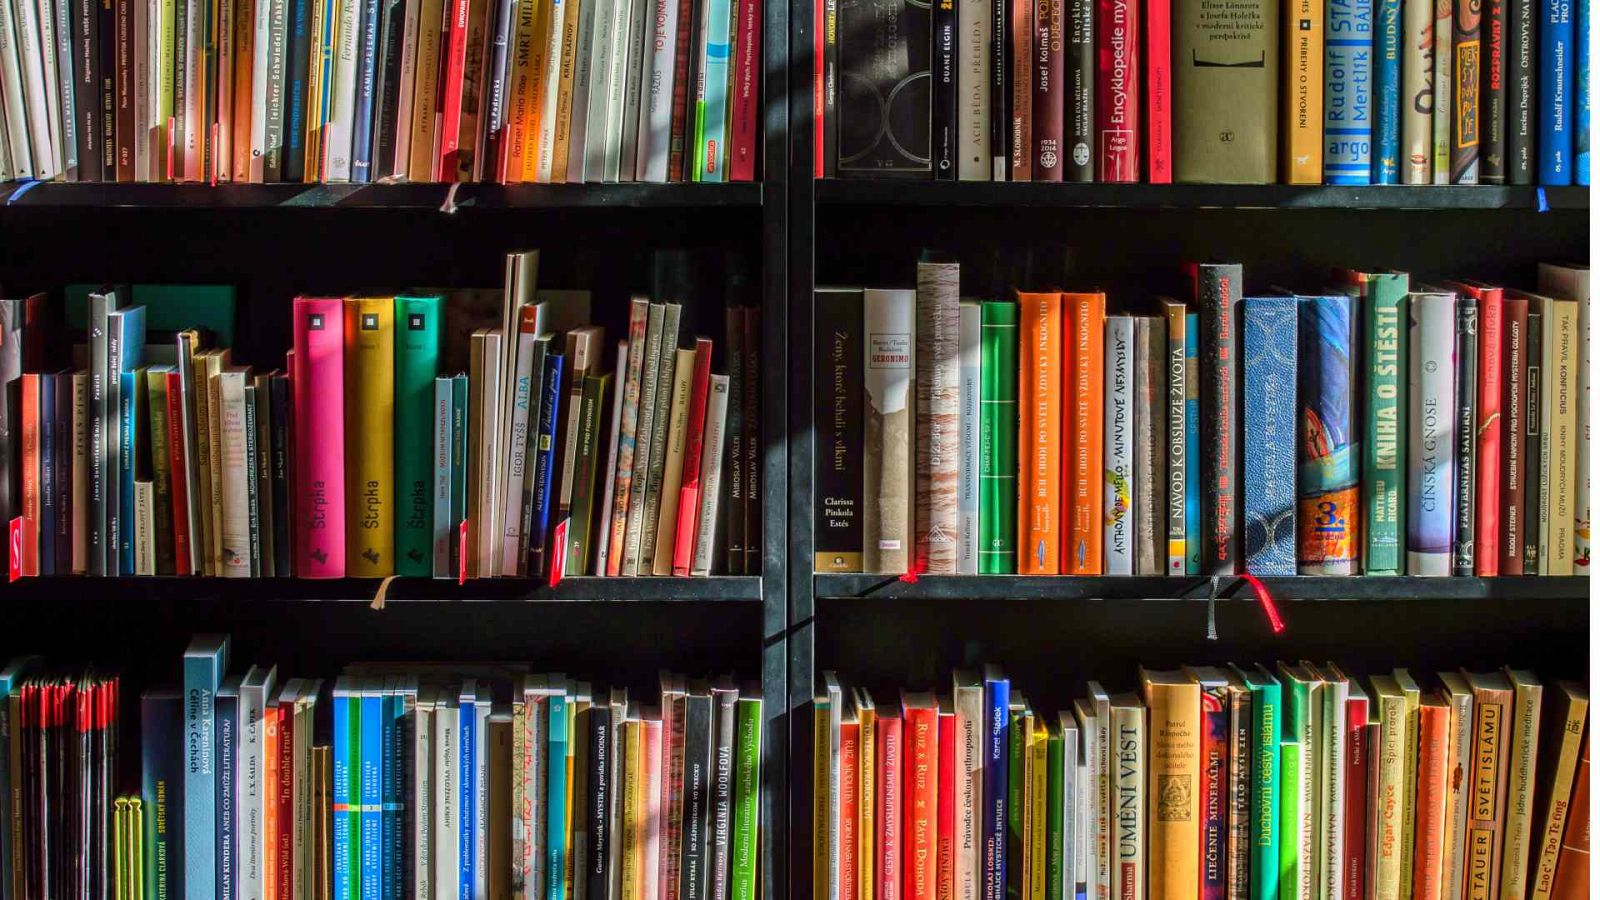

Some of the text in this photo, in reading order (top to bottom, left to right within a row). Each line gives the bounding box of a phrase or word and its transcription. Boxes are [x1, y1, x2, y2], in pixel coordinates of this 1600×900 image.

[943, 53, 951, 84] DUANE
[1039, 27, 1049, 92] Josef Kolmaš
[1110, 26, 1127, 124] Encyklopedie
[1489, 20, 1501, 90] ROZPRÁVKY
[1328, 50, 1346, 121] Rudolf
[1519, 110, 1529, 136] Lucien
[1554, 105, 1564, 132] Rudolf
[1329, 142, 1369, 162] argo
[516, 376, 529, 411] ALBA
[1038, 301, 1048, 443] PO INKOGNITO
[1079, 301, 1089, 443] PO INKOGNITO
[1169, 347, 1182, 396] ŽIVOTA
[1377, 383, 1397, 399] O
[1559, 364, 1568, 415] KONFUCIUS
[1171, 399, 1183, 455] OBSLUZE
[1376, 406, 1397, 470] KNIHA
[512, 451, 523, 478] IGOR
[1420, 398, 1437, 512] ČÍNSKÁ GNOSE
[731, 459, 740, 499] MIROSLAV
[748, 461, 757, 500] MIROSLAV
[1170, 471, 1182, 519] NÁVOD
[310, 480, 329, 529] Štrpka
[361, 480, 382, 529] Štrpka
[407, 480, 428, 529] Štrpka
[824, 497, 854, 506] Clarissa
[825, 508, 854, 516] Pinkola
[1508, 505, 1516, 531] STEINER
[1508, 532, 1516, 557] RUDOLF
[200, 688, 212, 774] Anna Kareninová
[1238, 728, 1246, 748] ZEN
[1521, 699, 1533, 738] meditace
[190, 731, 202, 774] Čechách
[281, 755, 291, 786] double
[993, 737, 1001, 760] Karel
[1260, 749, 1275, 784] cesty
[1114, 724, 1137, 859] UMĚNÍ VÉST
[1382, 704, 1398, 858] Edgar Cayce prorok
[1474, 709, 1496, 889] TAUER SVĚT ISLÁMU
[223, 798, 231, 810] CO
[223, 810, 231, 833] ANEB
[716, 801, 727, 846] VIRGINIA
[741, 796, 752, 832] literatury
[961, 779, 972, 850] Průvodce českou
[1207, 752, 1219, 880] LIEČENIE MINERÁLMI
[1257, 787, 1273, 848] Duchovní
[223, 834, 231, 873] KUNDERA
